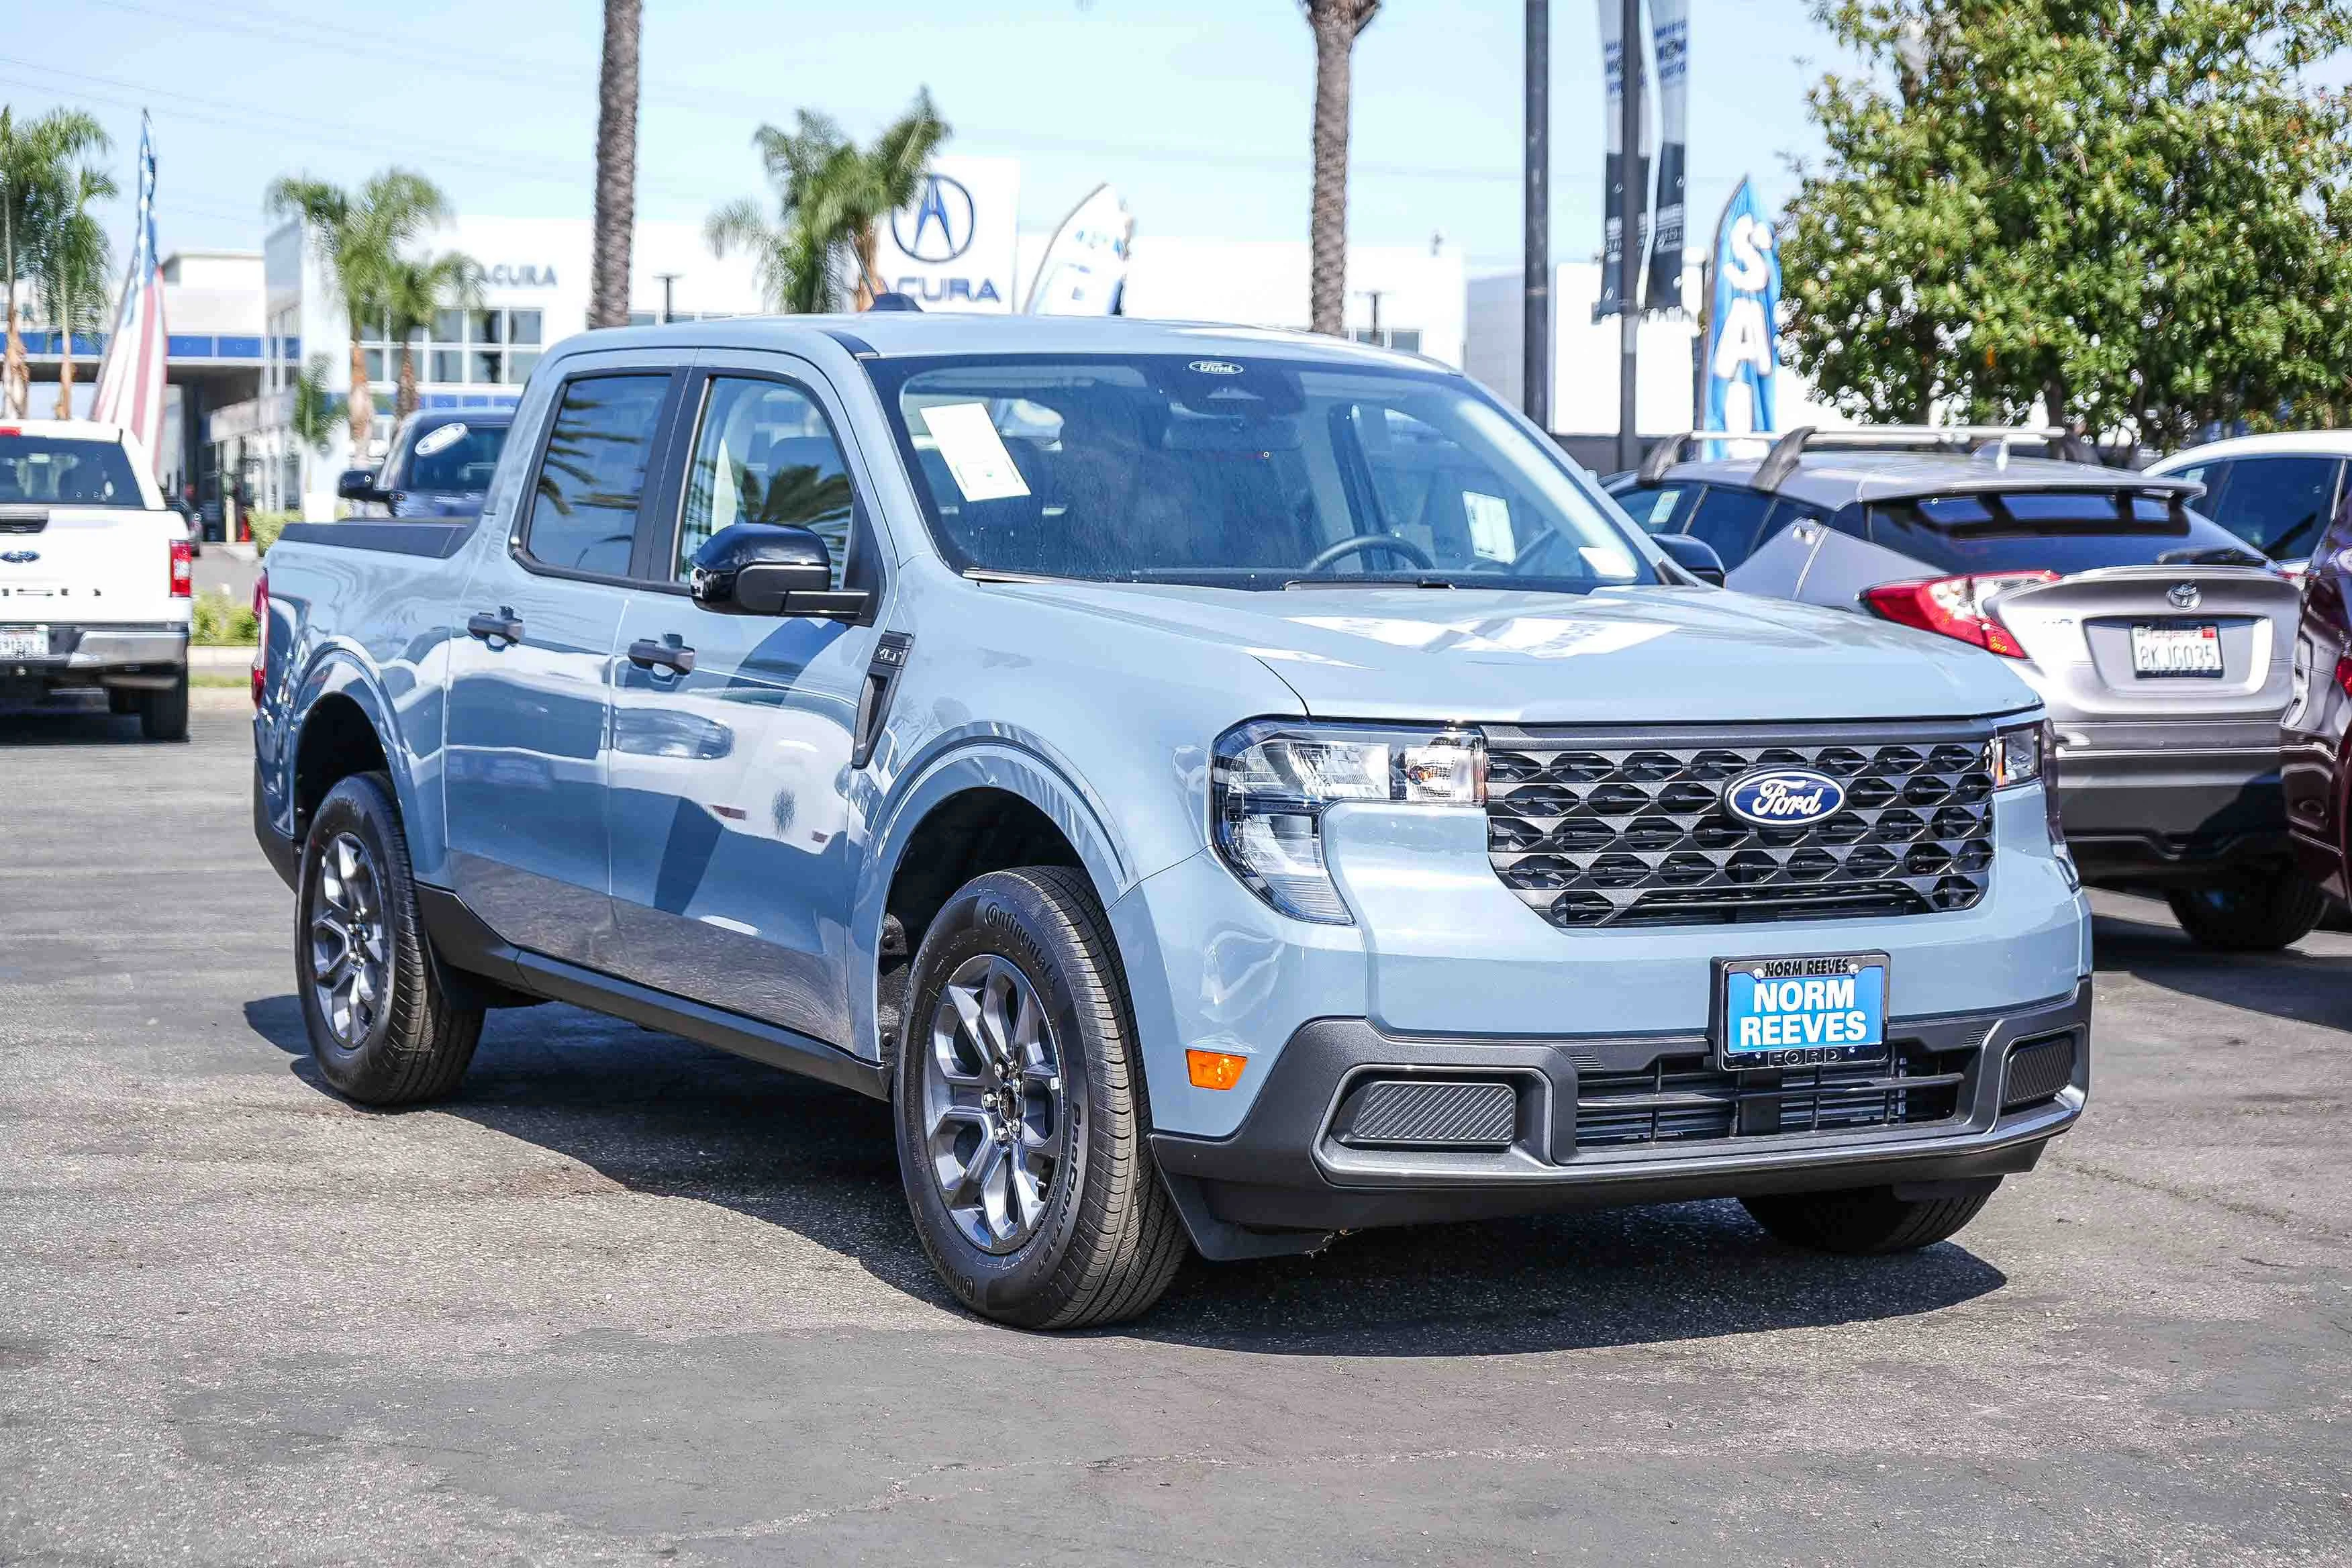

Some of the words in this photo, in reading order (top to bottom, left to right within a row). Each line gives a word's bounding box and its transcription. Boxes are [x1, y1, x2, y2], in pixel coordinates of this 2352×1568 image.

[883, 277, 1001, 303] CURA
[1752, 779, 1824, 816] Ford
[985, 902, 1054, 977] Continental
[1765, 961, 1802, 977] NORM
[1806, 958, 1848, 975] REEVES
[1753, 979, 1855, 1013] NORM
[1740, 1010, 1867, 1046] REEVES
[1767, 1047, 1843, 1067] FORD
